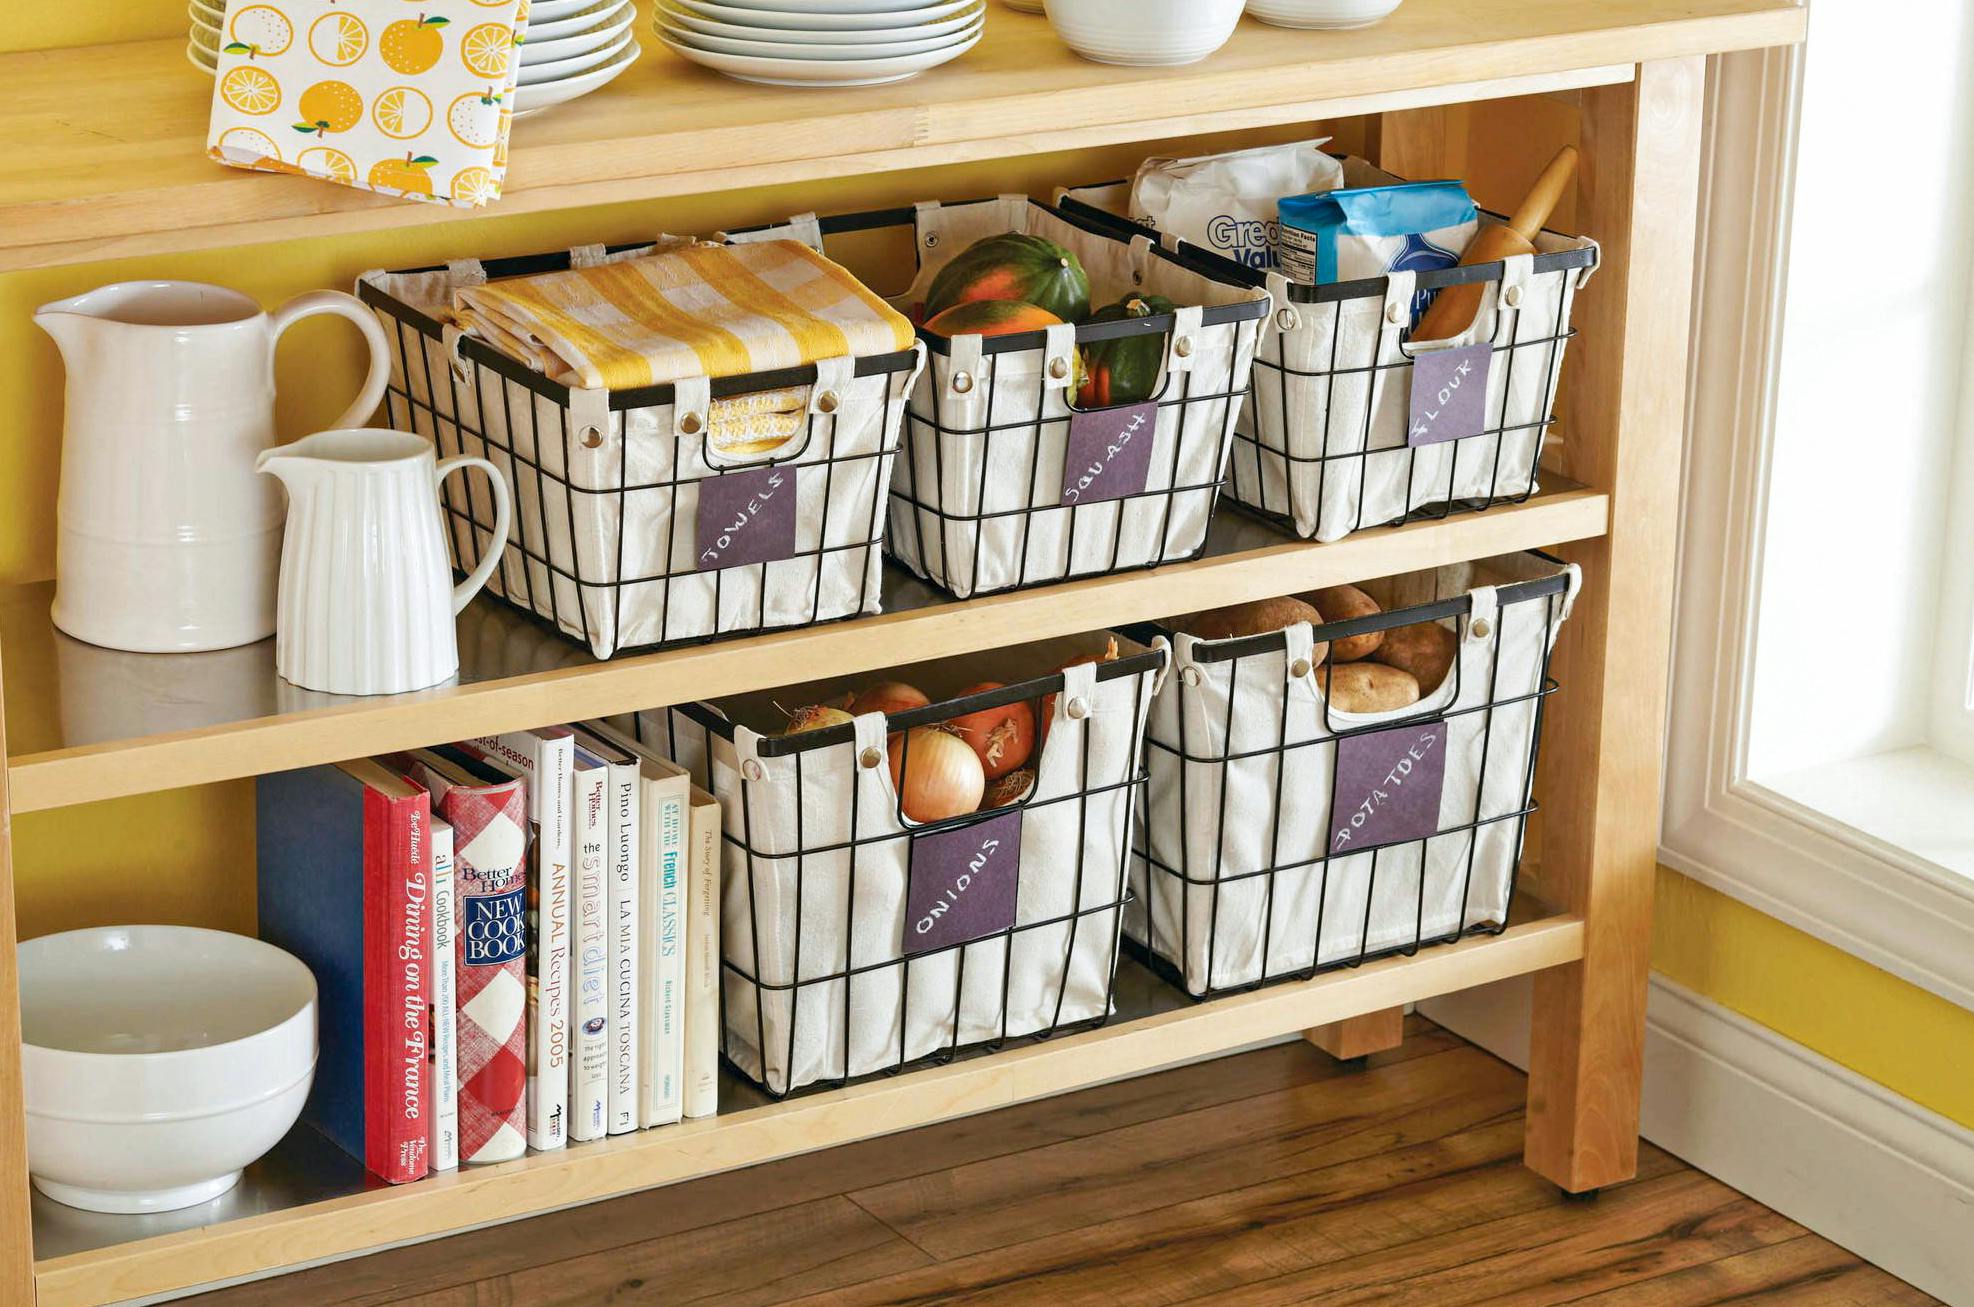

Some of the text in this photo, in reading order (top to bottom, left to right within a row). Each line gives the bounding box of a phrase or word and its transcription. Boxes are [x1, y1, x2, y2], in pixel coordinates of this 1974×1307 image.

[1207, 215, 1280, 249] Grea
[1412, 359, 1472, 438] FLOUR
[1064, 412, 1146, 503] SQUASH
[701, 472, 784, 561] TOWELS
[1335, 732, 1436, 850] POTATOES
[463, 866, 512, 881] Better
[584, 843, 601, 854] the
[916, 839, 1000, 934] ONIONS
[436, 890, 451, 950] Cookbook
[468, 911, 525, 941] COOK
[469, 930, 525, 959] BOOK
[476, 893, 523, 921] NEW
[583, 856, 606, 1006] smart diet
[617, 782, 632, 1095] Pino Luongo LA MIA CUCINA TOSCANA
[661, 852, 678, 957] French CLASSICS
[399, 872, 426, 1119] Dining on the France
[546, 863, 566, 1068] ANNUAL Recipes 2005
